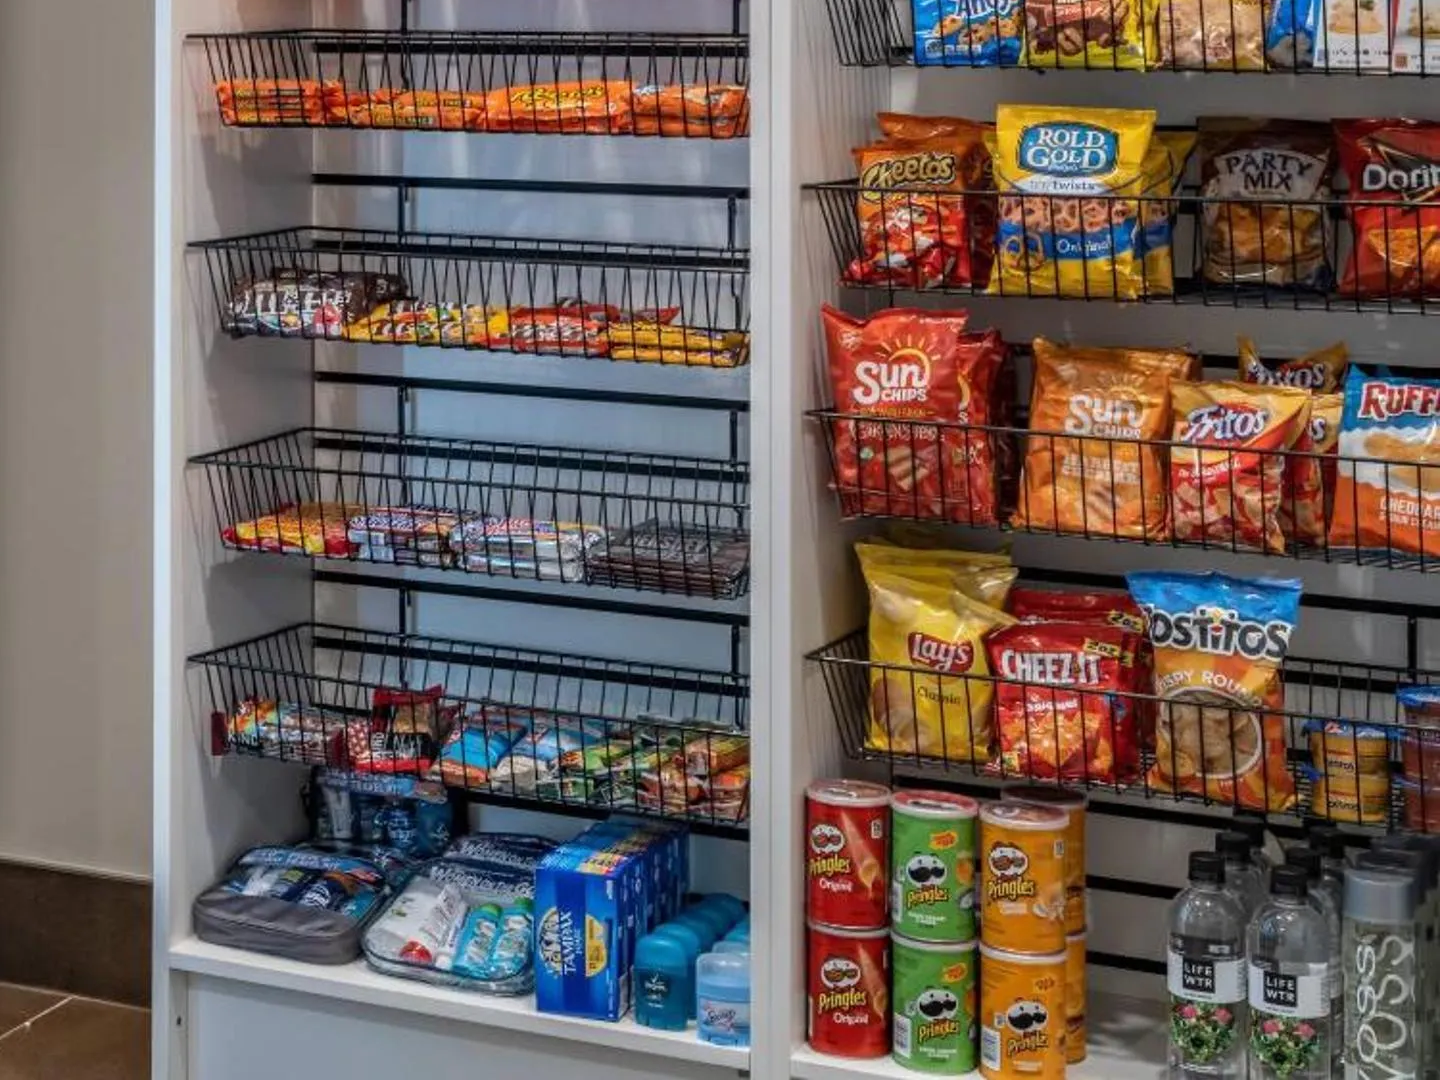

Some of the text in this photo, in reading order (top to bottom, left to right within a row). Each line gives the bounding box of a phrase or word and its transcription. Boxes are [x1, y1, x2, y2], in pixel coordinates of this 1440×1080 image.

[1037, 127, 1105, 148] ROLD
[1026, 146, 1107, 170] GOLD
[1225, 153, 1312, 175] PARTY
[862, 154, 957, 190] Cheetos
[1243, 172, 1293, 192] MIX
[853, 360, 929, 405] Sun
[880, 387, 929, 402] CHIPS
[1064, 392, 1147, 435] Sun
[1184, 404, 1269, 442] Fritos
[1147, 606, 1295, 660] OSTITOS
[911, 633, 971, 670] Lay's
[988, 879, 1034, 899] Pringles
[561, 910, 577, 976] TAMPAX
[1184, 963, 1213, 976] LIFE
[1184, 975, 1213, 989] WTR
[1266, 978, 1294, 991] LIFE
[819, 990, 866, 1014] Pringles
[1267, 988, 1295, 1002] WTR
[918, 1020, 960, 1043] Pringles
